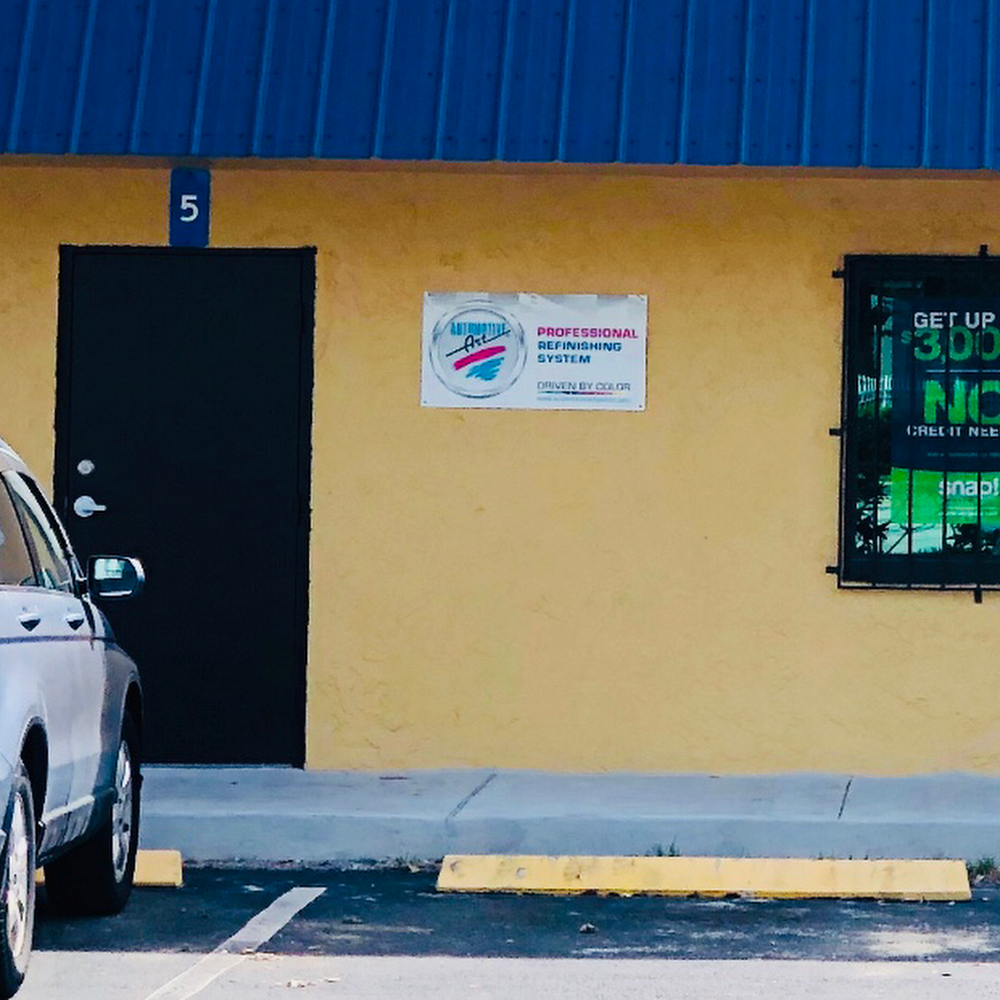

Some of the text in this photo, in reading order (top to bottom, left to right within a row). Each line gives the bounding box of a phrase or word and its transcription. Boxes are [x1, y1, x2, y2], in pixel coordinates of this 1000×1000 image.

[180, 194, 199, 222] 5
[914, 311, 958, 329] GET
[965, 311, 996, 329] UP
[537, 326, 639, 339] PROFESSIONAL
[537, 340, 622, 352] REFINISHING
[537, 353, 591, 364] SYSTEM
[537, 381, 631, 392] DRIVEN BY COLOR
